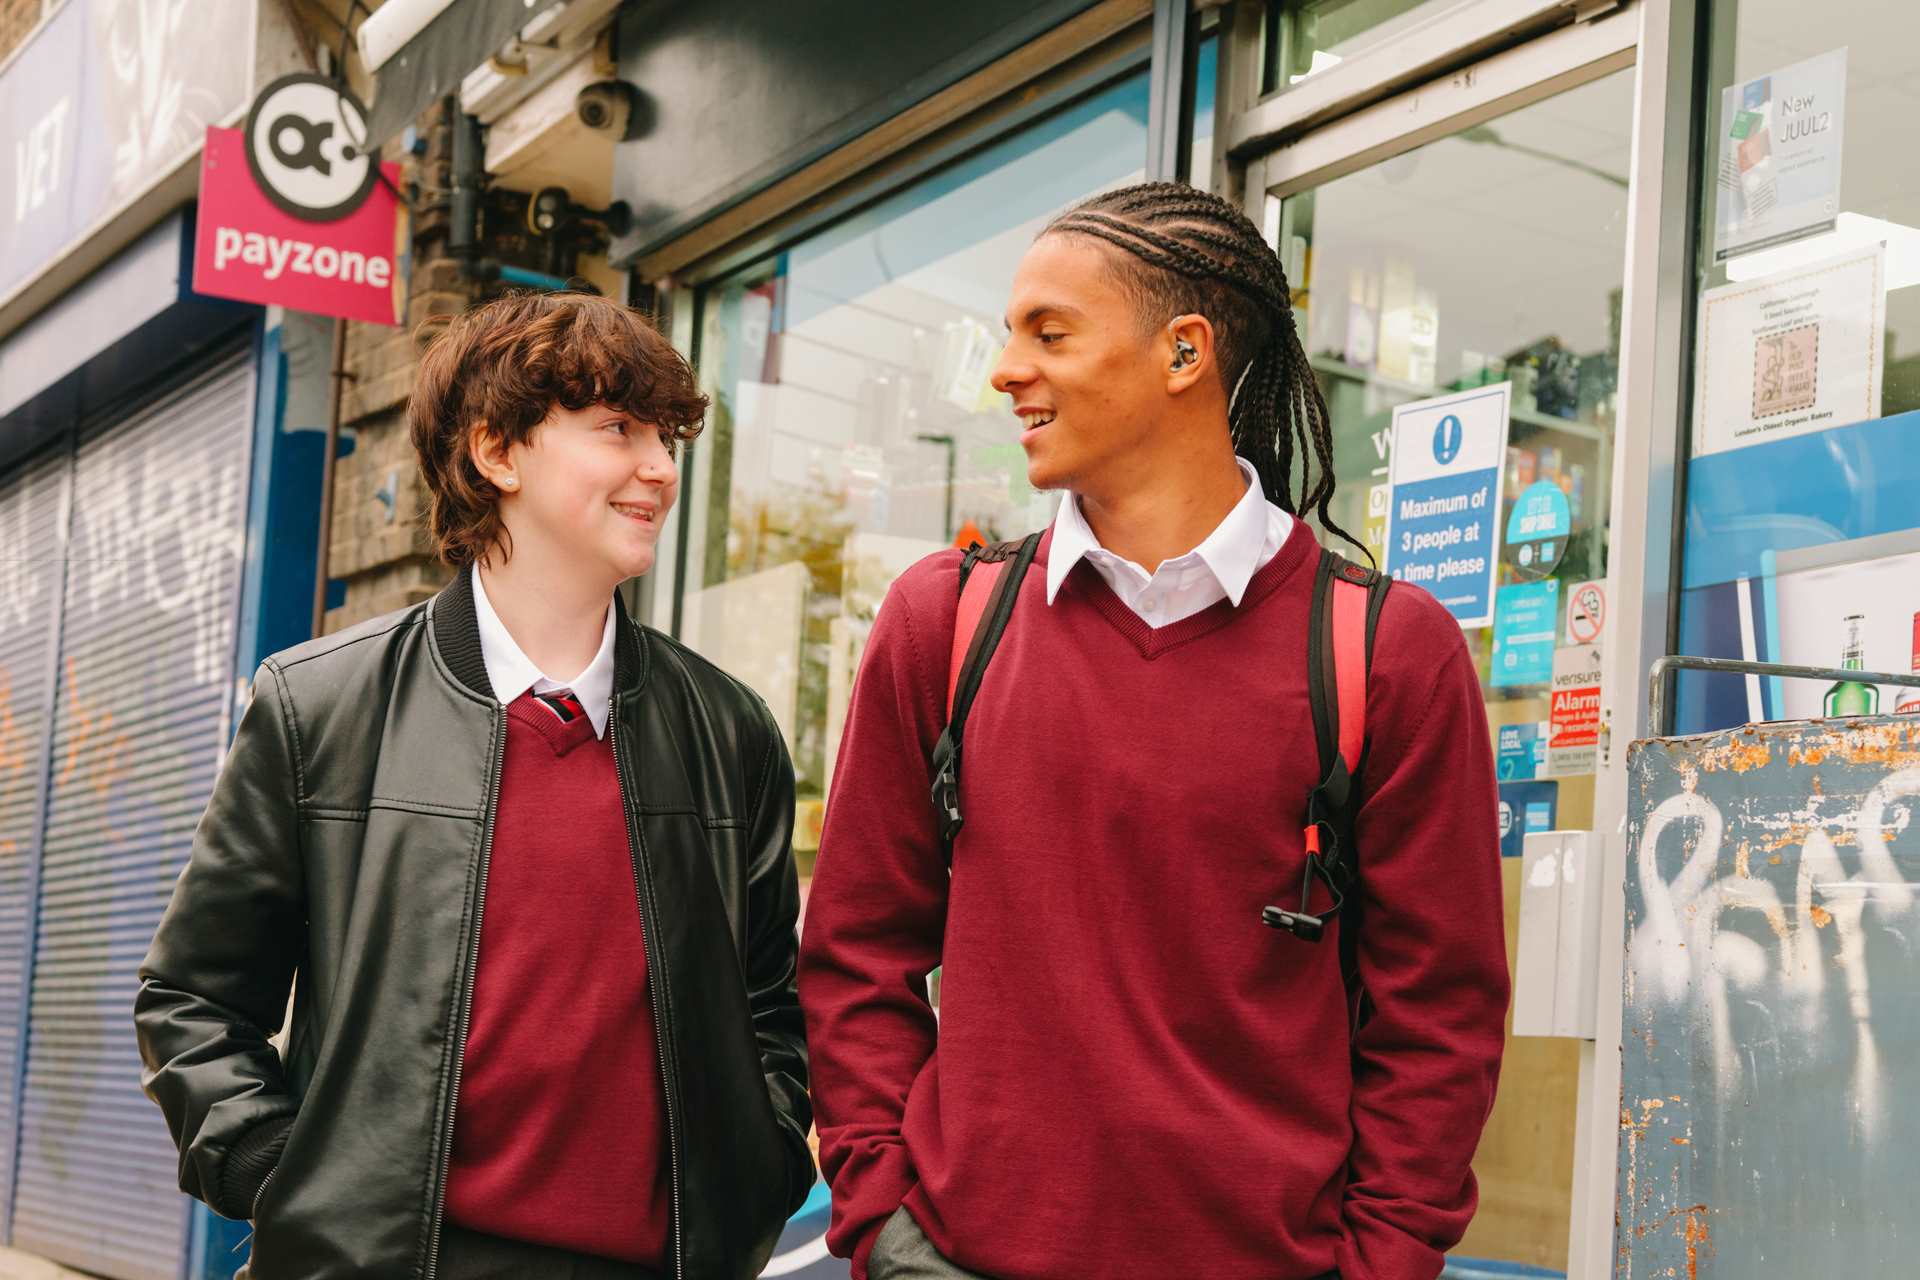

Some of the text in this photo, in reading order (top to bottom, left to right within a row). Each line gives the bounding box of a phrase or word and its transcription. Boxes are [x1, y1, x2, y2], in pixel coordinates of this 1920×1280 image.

[1782, 95, 1815, 117] New
[1780, 111, 1829, 143] JUUL2
[16, 97, 69, 223] VET
[214, 226, 391, 288] payzone
[1734, 410, 1833, 438] London's Oldest Organic Bakery
[1400, 495, 1468, 520] Maximum
[1471, 486, 1488, 509] of
[1402, 531, 1411, 552] 3
[1413, 524, 1461, 554] people
[1464, 521, 1480, 542] at
[1393, 556, 1485, 583] a time please
[1555, 671, 1601, 686] verisure
[1554, 692, 1600, 712] Alarm
